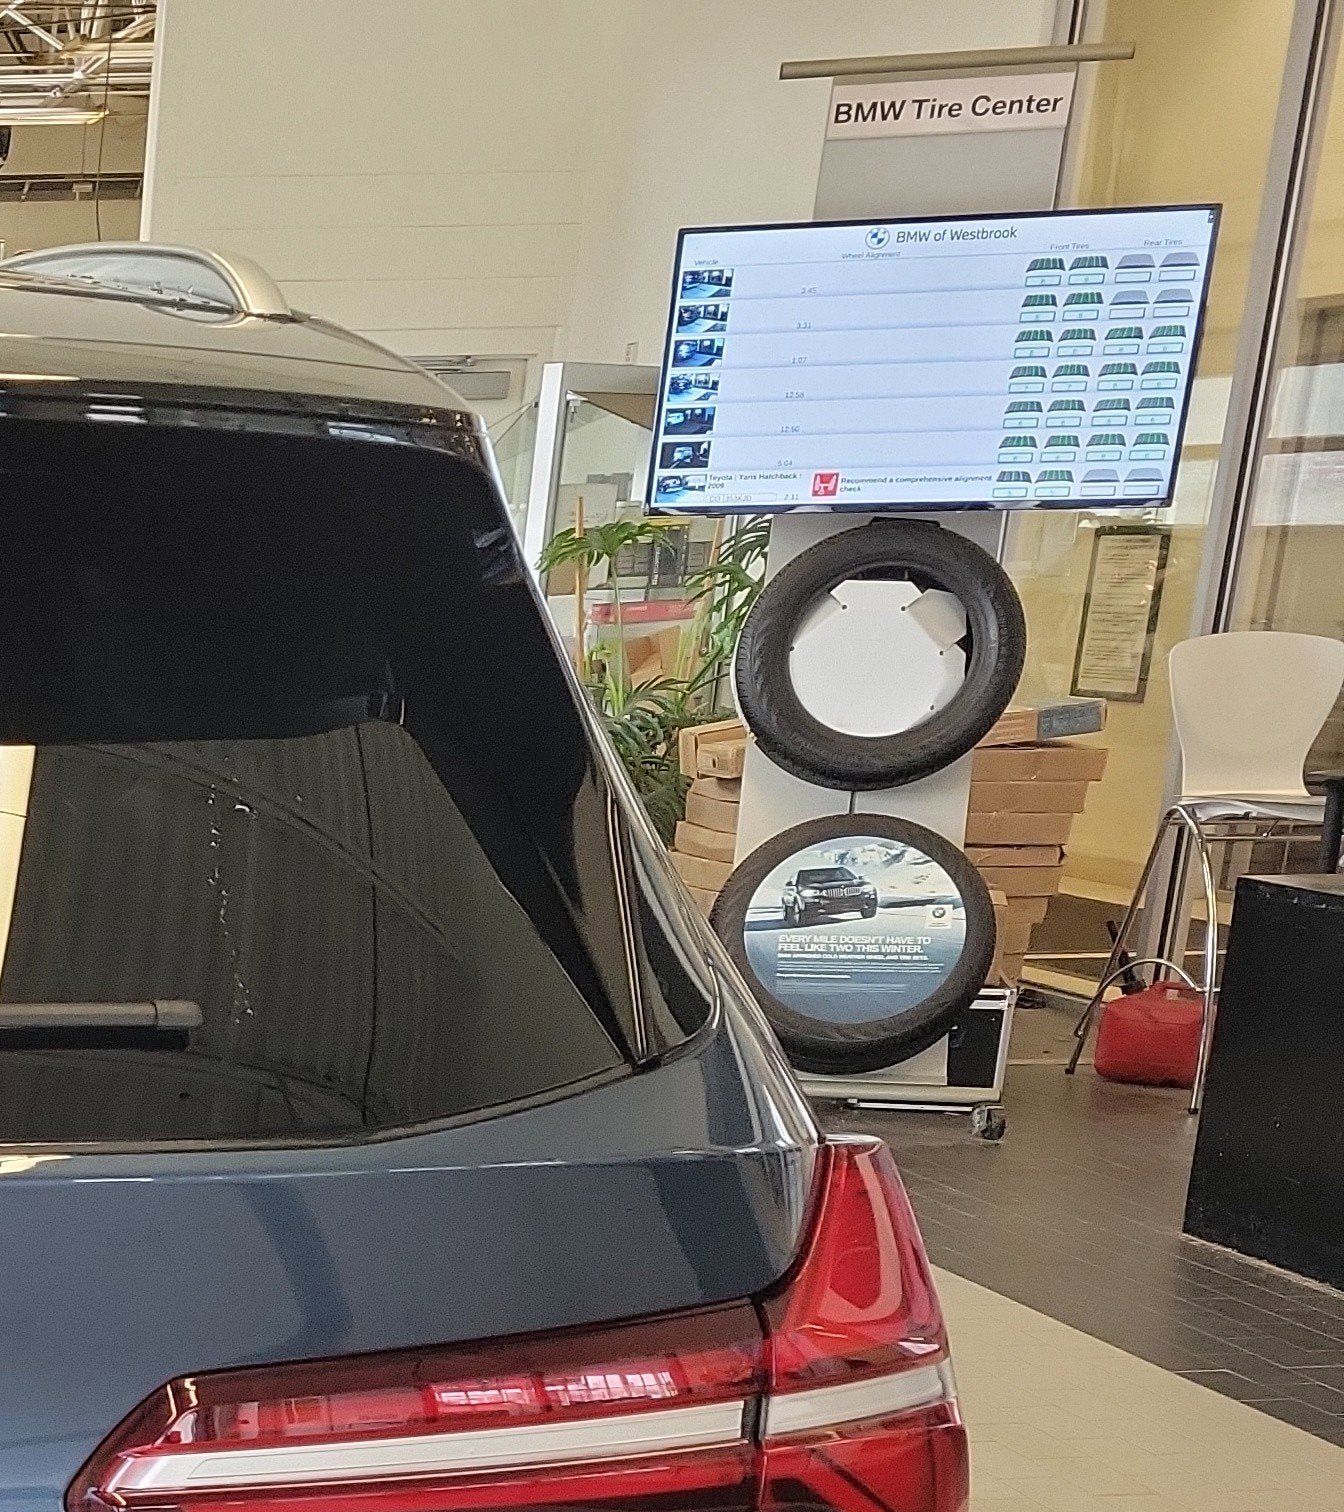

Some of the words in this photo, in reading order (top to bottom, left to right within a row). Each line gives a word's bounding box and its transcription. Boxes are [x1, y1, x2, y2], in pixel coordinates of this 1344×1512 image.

[834, 99, 906, 124] BMW
[911, 98, 962, 120] Tire
[971, 95, 1064, 117] Center
[896, 229, 931, 243] BMW
[934, 228, 946, 242] of
[949, 226, 1017, 241] Westbrook
[759, 472, 798, 480] Hatchback
[841, 476, 887, 484] Recommend
[895, 475, 953, 484] comprehensive
[954, 474, 993, 483] alignment
[778, 934, 812, 943] EVERY
[813, 934, 838, 943] MILE
[839, 935, 885, 944] DOESN'T
[886, 936, 915, 944] HAVE
[917, 936, 931, 945] TO
[778, 943, 804, 951] FEEL
[805, 943, 828, 952] LIKE
[829, 944, 854, 952] TWO
[855, 944, 879, 953] THIS
